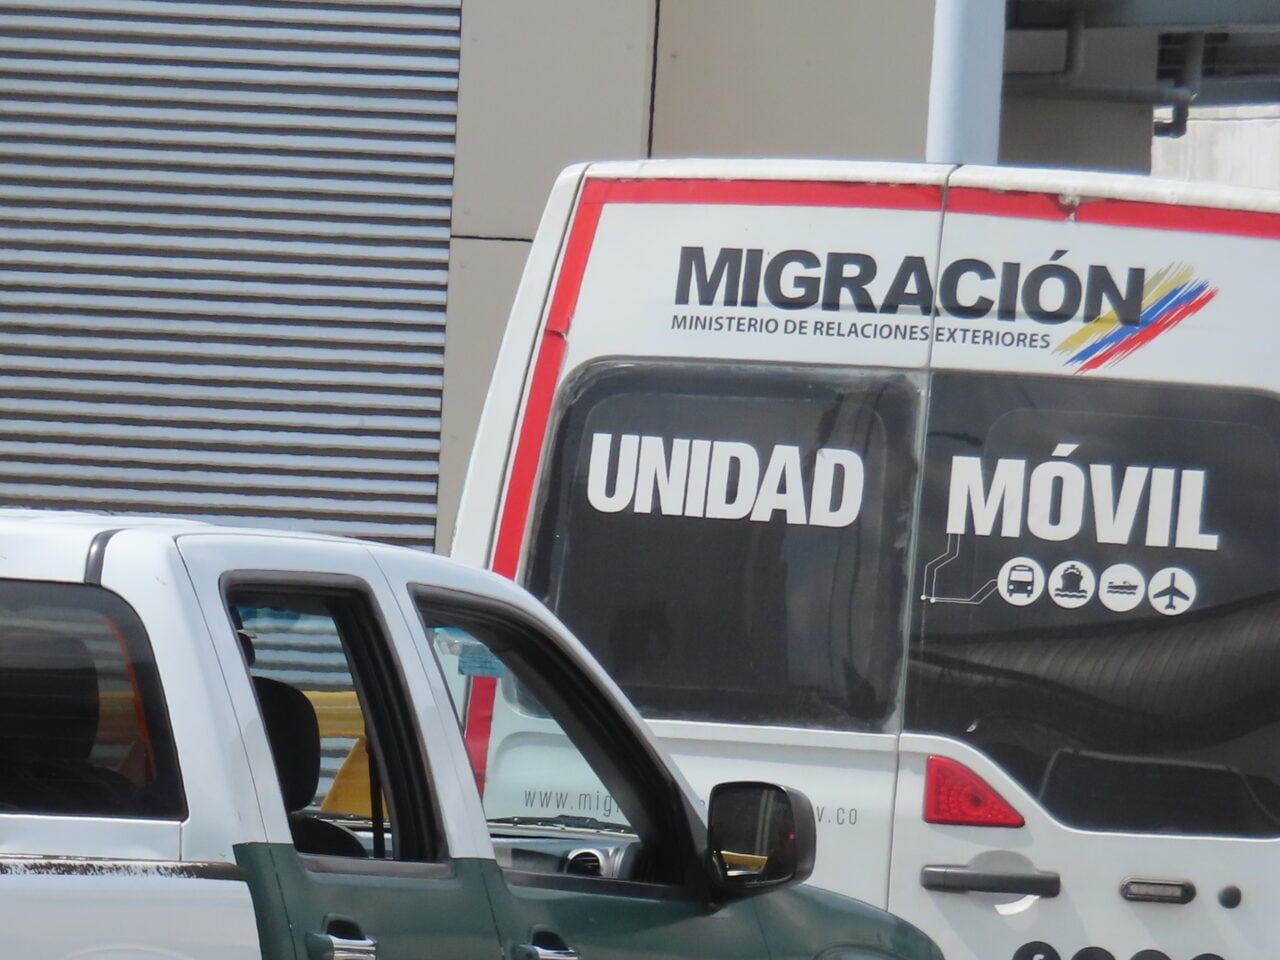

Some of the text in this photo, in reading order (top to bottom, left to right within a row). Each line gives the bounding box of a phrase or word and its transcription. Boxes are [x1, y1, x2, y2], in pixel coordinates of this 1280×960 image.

[675, 246, 1145, 327] MIGRACIÓN
[671, 314, 1051, 349] MINISTERIO DE RELACIONES EXTERIORES
[587, 432, 865, 528] UNIDAD
[946, 443, 1219, 551] MÓVIL
